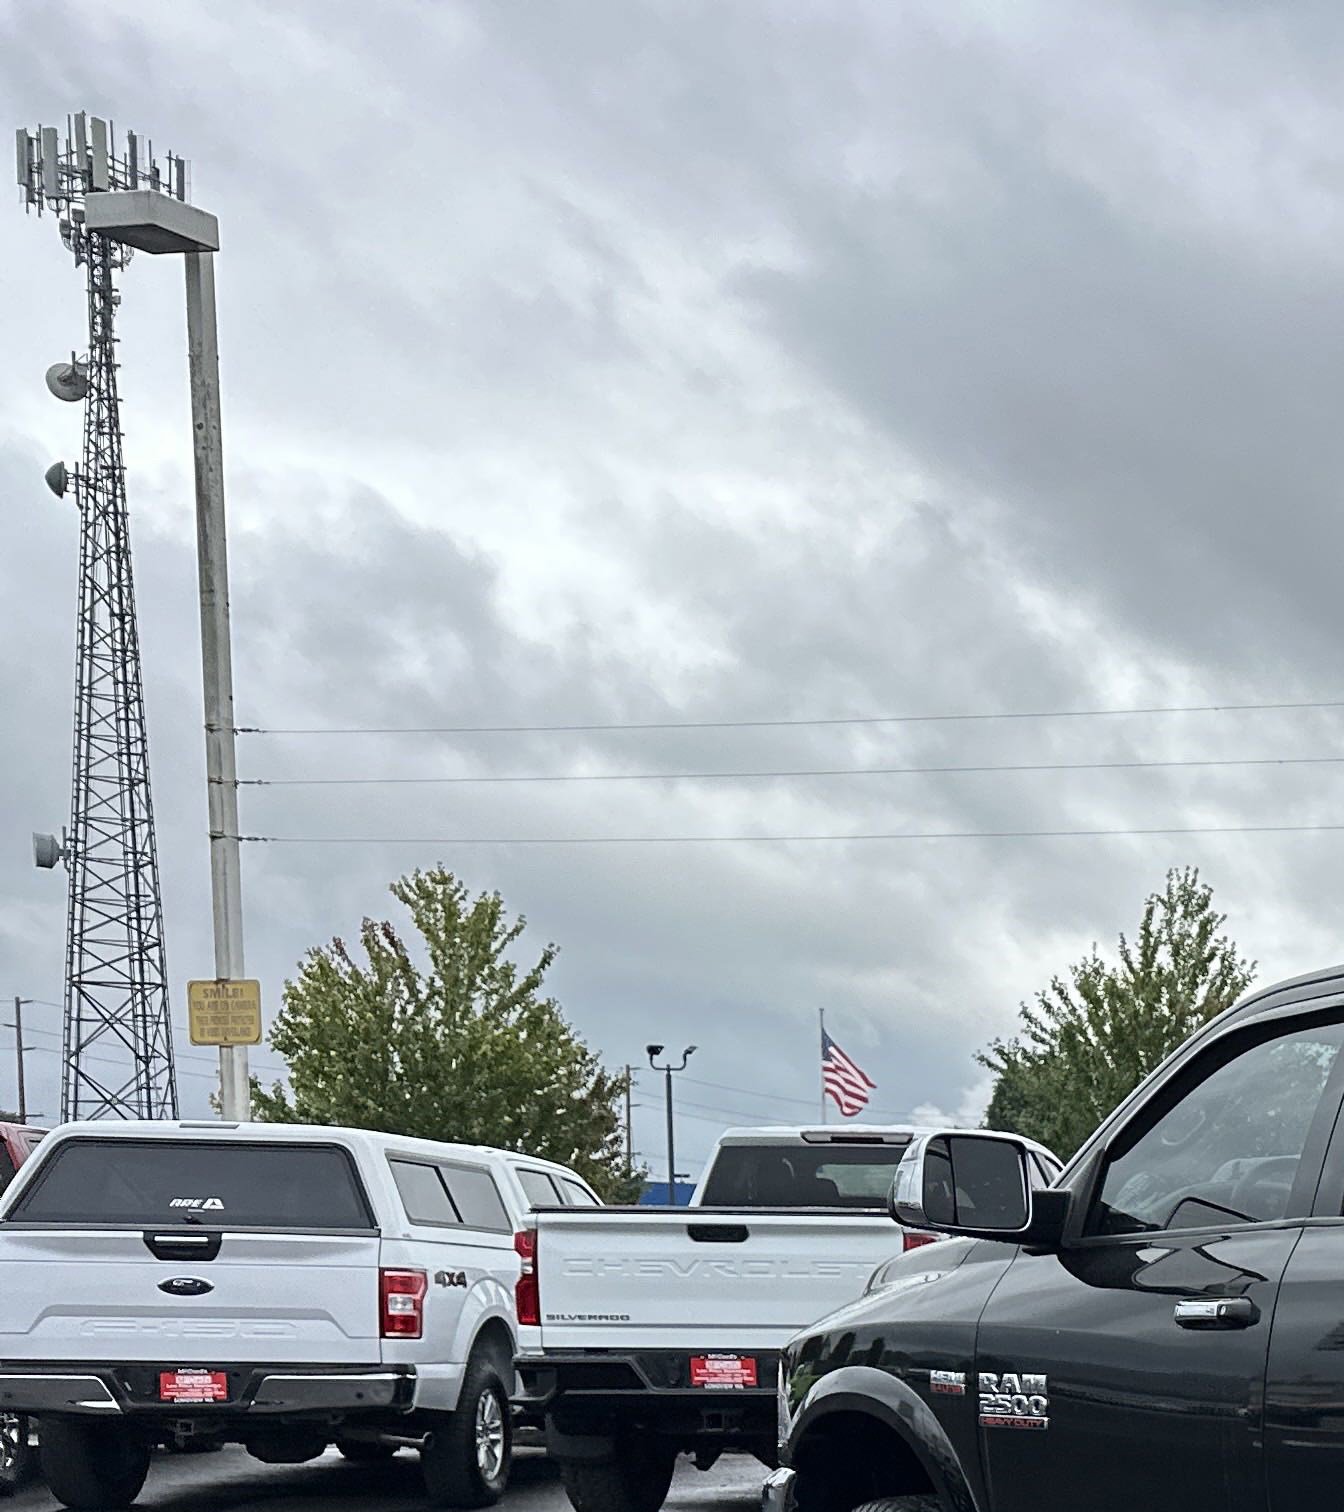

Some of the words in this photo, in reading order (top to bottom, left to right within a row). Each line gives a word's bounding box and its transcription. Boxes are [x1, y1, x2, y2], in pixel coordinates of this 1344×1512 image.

[203, 988, 243, 999] SMILE!
[562, 1258, 878, 1279] CHEVROLET
[546, 1314, 630, 1322] SILVERADO
[978, 1372, 1048, 1394] RAM
[978, 1393, 1048, 1416] 2500
